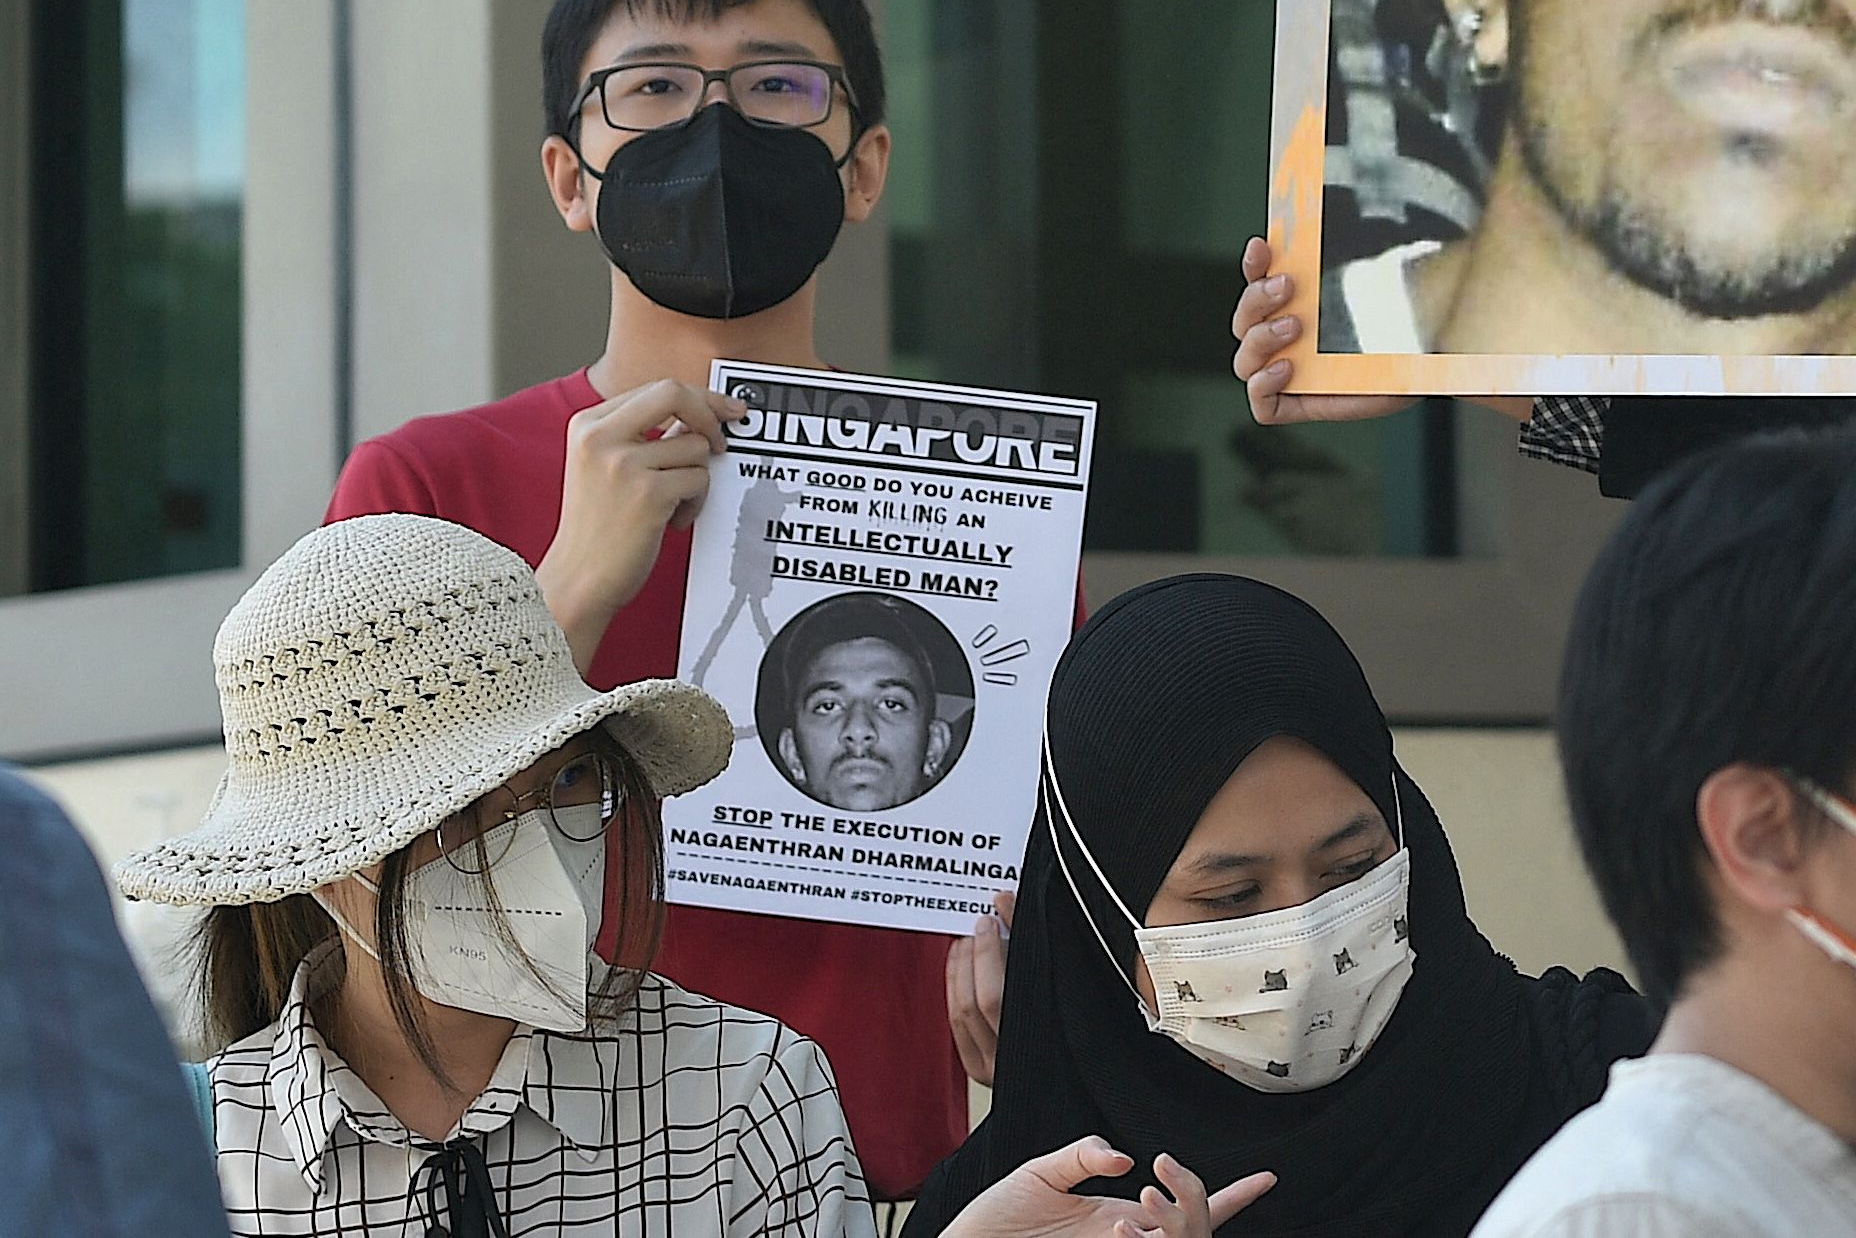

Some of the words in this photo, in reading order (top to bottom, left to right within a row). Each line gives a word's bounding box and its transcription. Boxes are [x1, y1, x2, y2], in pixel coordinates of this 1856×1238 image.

[727, 382, 1078, 473] SINGAPORE
[740, 463, 800, 481] WHAT
[807, 471, 865, 489] GOOD
[874, 478, 901, 493] DO
[911, 482, 953, 498] YOU
[961, 489, 1052, 510] ACHEIVE
[800, 495, 858, 514] FROM
[869, 500, 947, 525] KILLING
[957, 514, 985, 528] AN
[766, 520, 1012, 563] INTELLECTUALLY
[772, 556, 910, 587] DISABLED
[921, 573, 998, 597] MAN?
[712, 806, 772, 829] STOP
[781, 812, 826, 831] THE
[833, 819, 963, 846] EXECUTION
[972, 835, 1000, 850] OF
[671, 829, 843, 861] NAGAENTHRAN
[852, 849, 1017, 880] DHARMALINGA
[668, 871, 845, 898] #SAVENAGAENTHRAN
[449, 946, 486, 962] KN95
